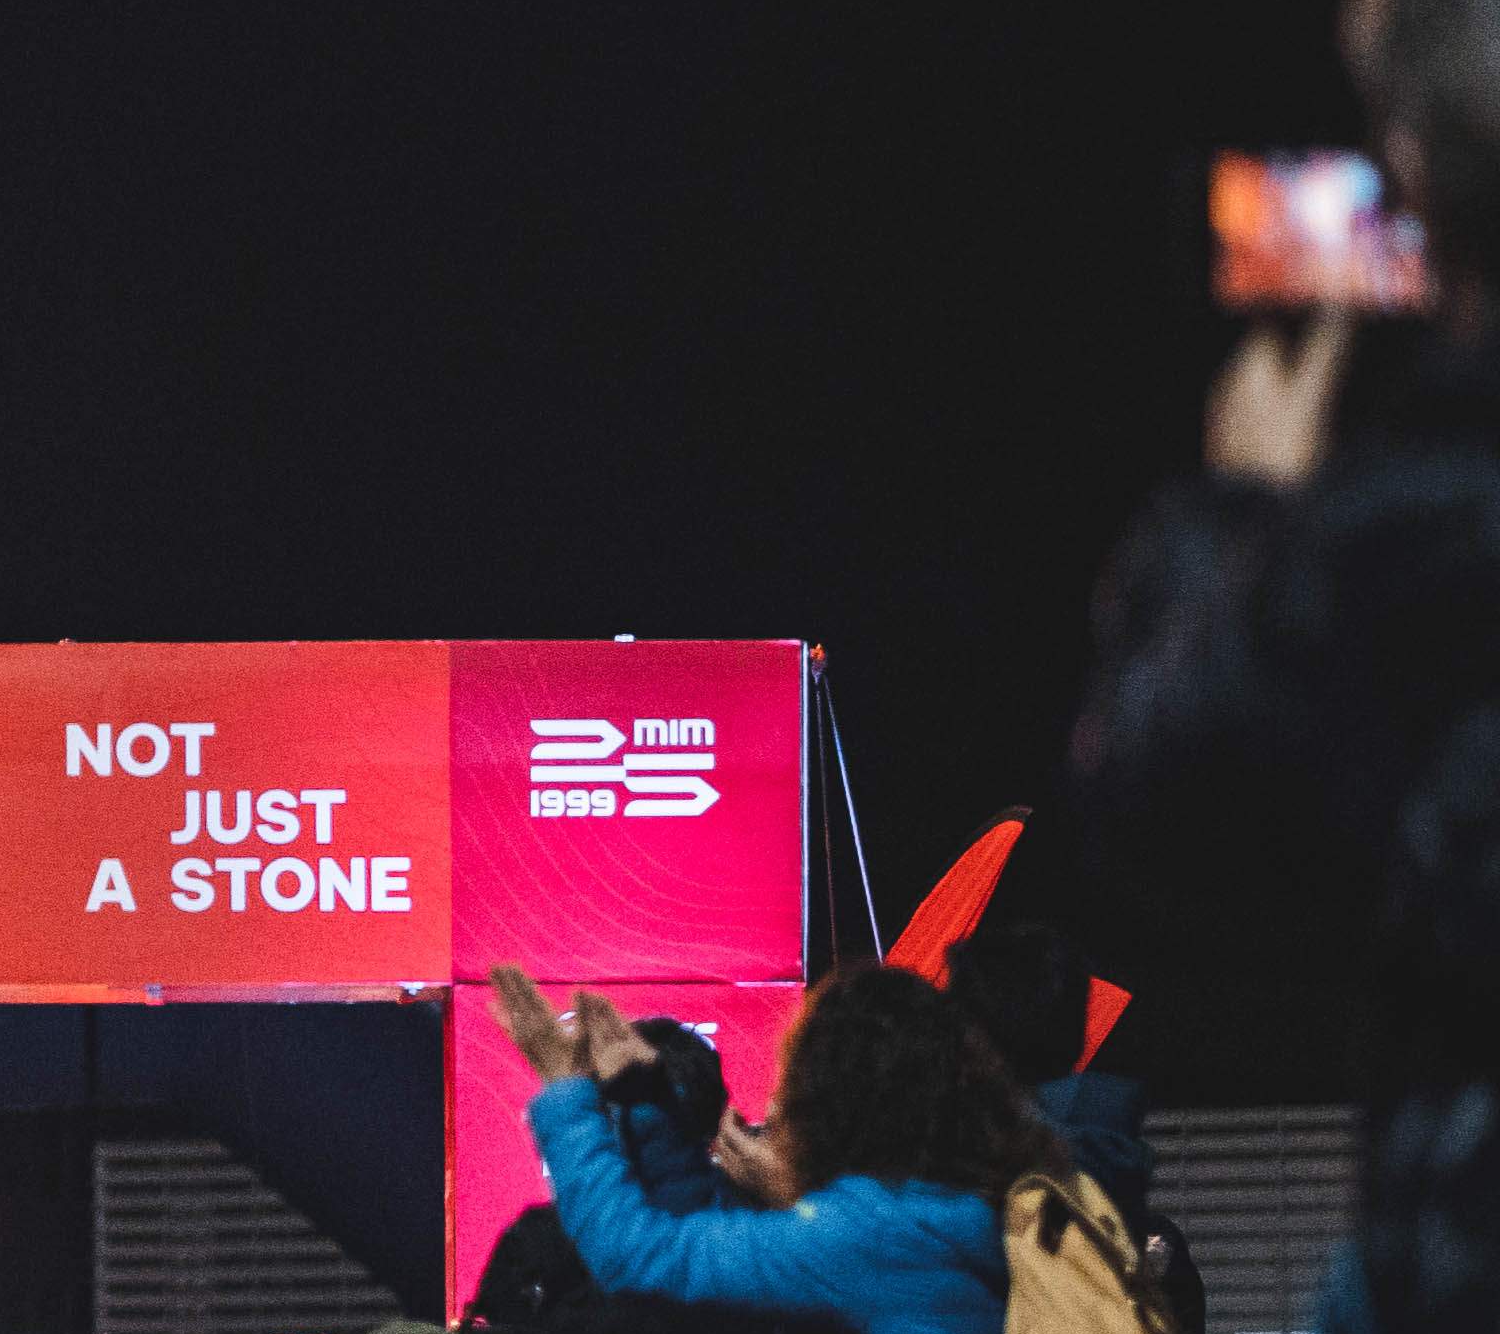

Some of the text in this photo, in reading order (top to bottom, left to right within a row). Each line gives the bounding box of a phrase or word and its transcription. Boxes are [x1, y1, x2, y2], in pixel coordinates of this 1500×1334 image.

[65, 723, 216, 777] NOT
[170, 790, 347, 845] JUST
[530, 789, 616, 817] 1999
[85, 857, 412, 913] A STONE
